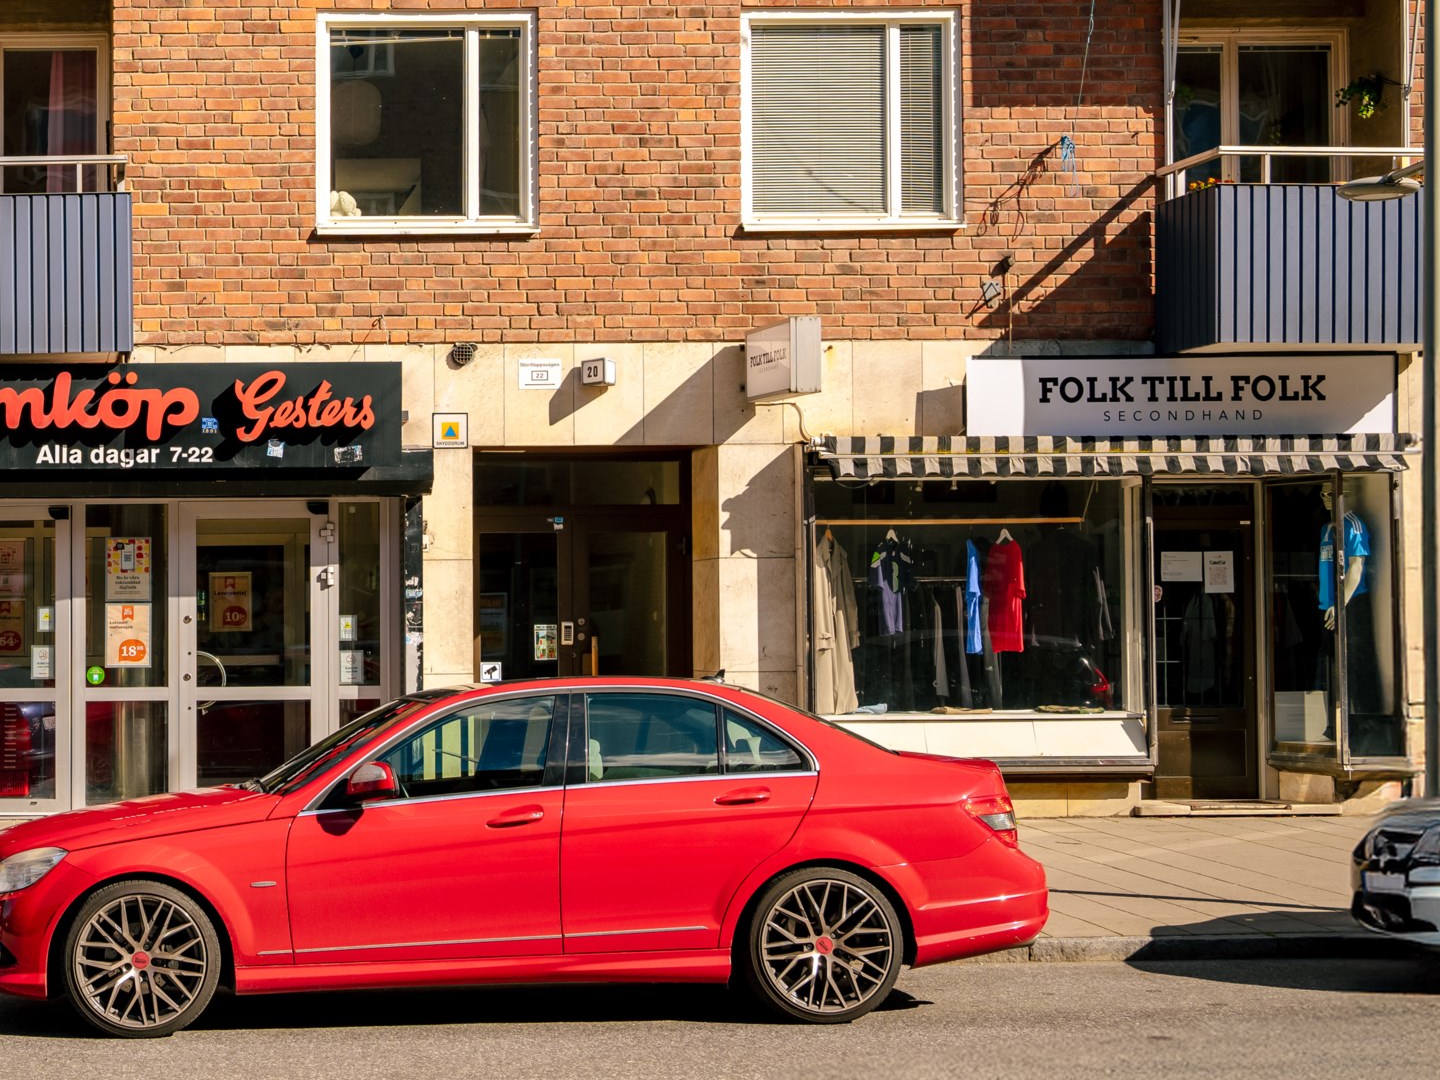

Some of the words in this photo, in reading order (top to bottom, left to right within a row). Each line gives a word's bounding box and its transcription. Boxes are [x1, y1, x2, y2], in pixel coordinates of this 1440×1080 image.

[750, 354, 763, 368] FOLK
[763, 352, 773, 365] TILL
[587, 365, 599, 378] 20
[1039, 376, 1135, 404] FOLK
[1142, 376, 1223, 402] TILL
[1230, 374, 1327, 402] FOLK
[234, 371, 375, 442] Gesters
[1103, 409, 1263, 423] SECONDHAND
[36, 444, 82, 465] Alla
[90, 444, 160, 469] dagar
[169, 446, 213, 464] 7-22
